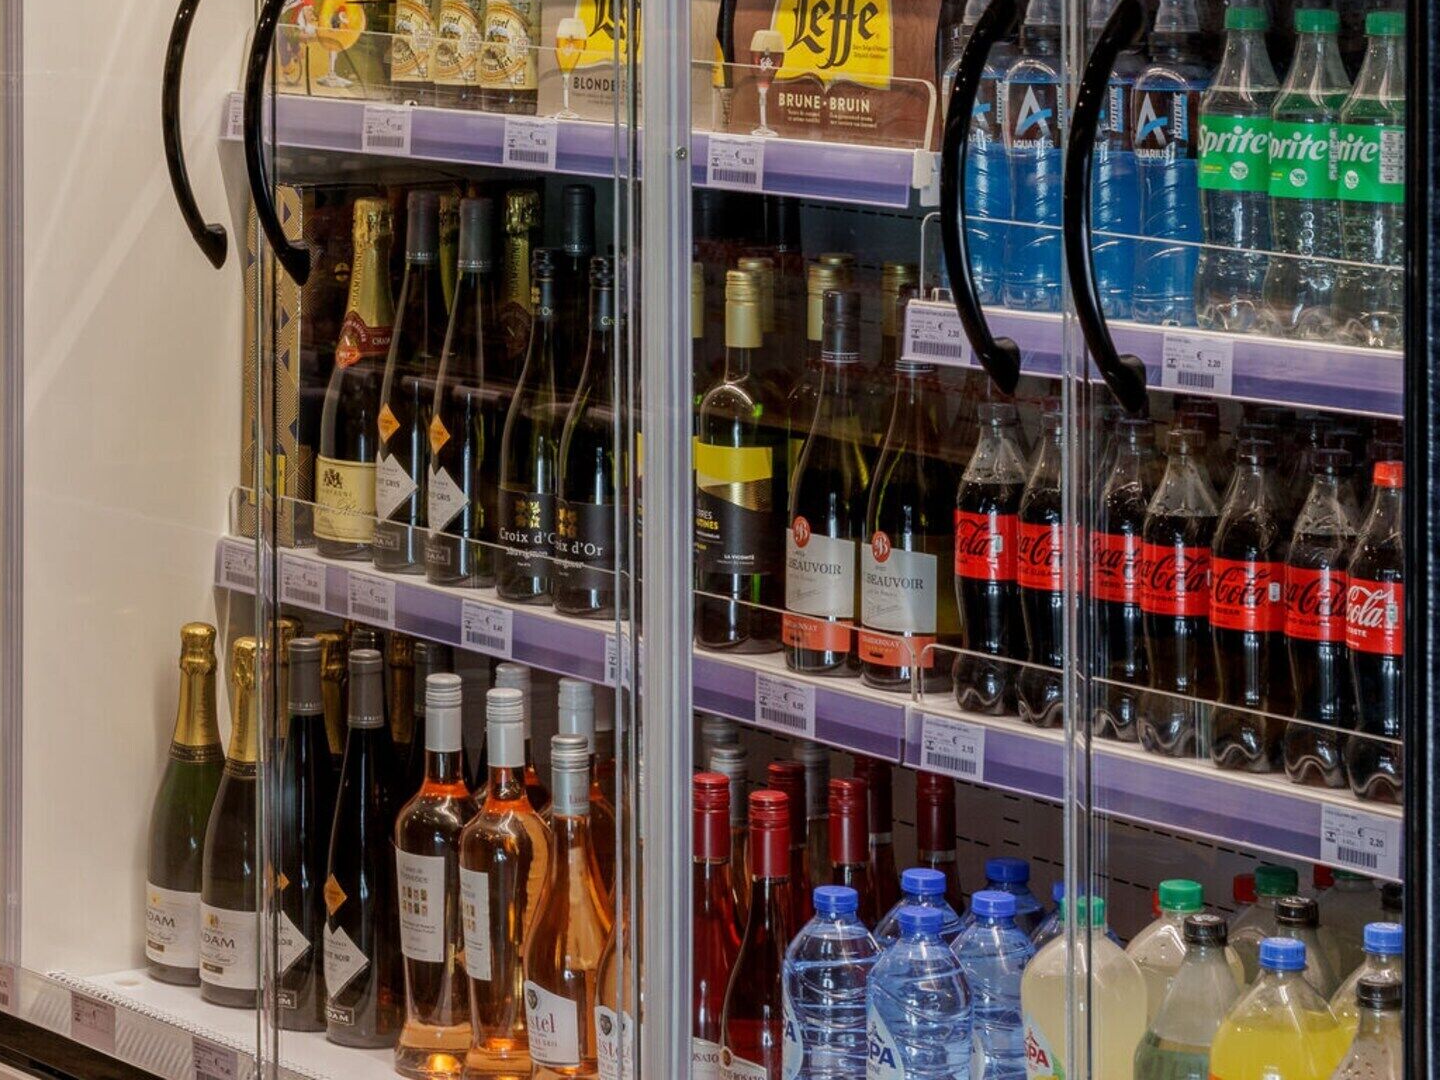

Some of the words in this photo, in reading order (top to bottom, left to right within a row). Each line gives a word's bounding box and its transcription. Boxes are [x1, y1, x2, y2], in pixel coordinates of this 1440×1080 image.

[778, 93, 821, 109] BRUNE
[829, 97, 870, 113] BRUIN
[1198, 124, 1268, 158] Sprite
[499, 526, 529, 544] Croix
[867, 572, 924, 590] BEAUVOIR
